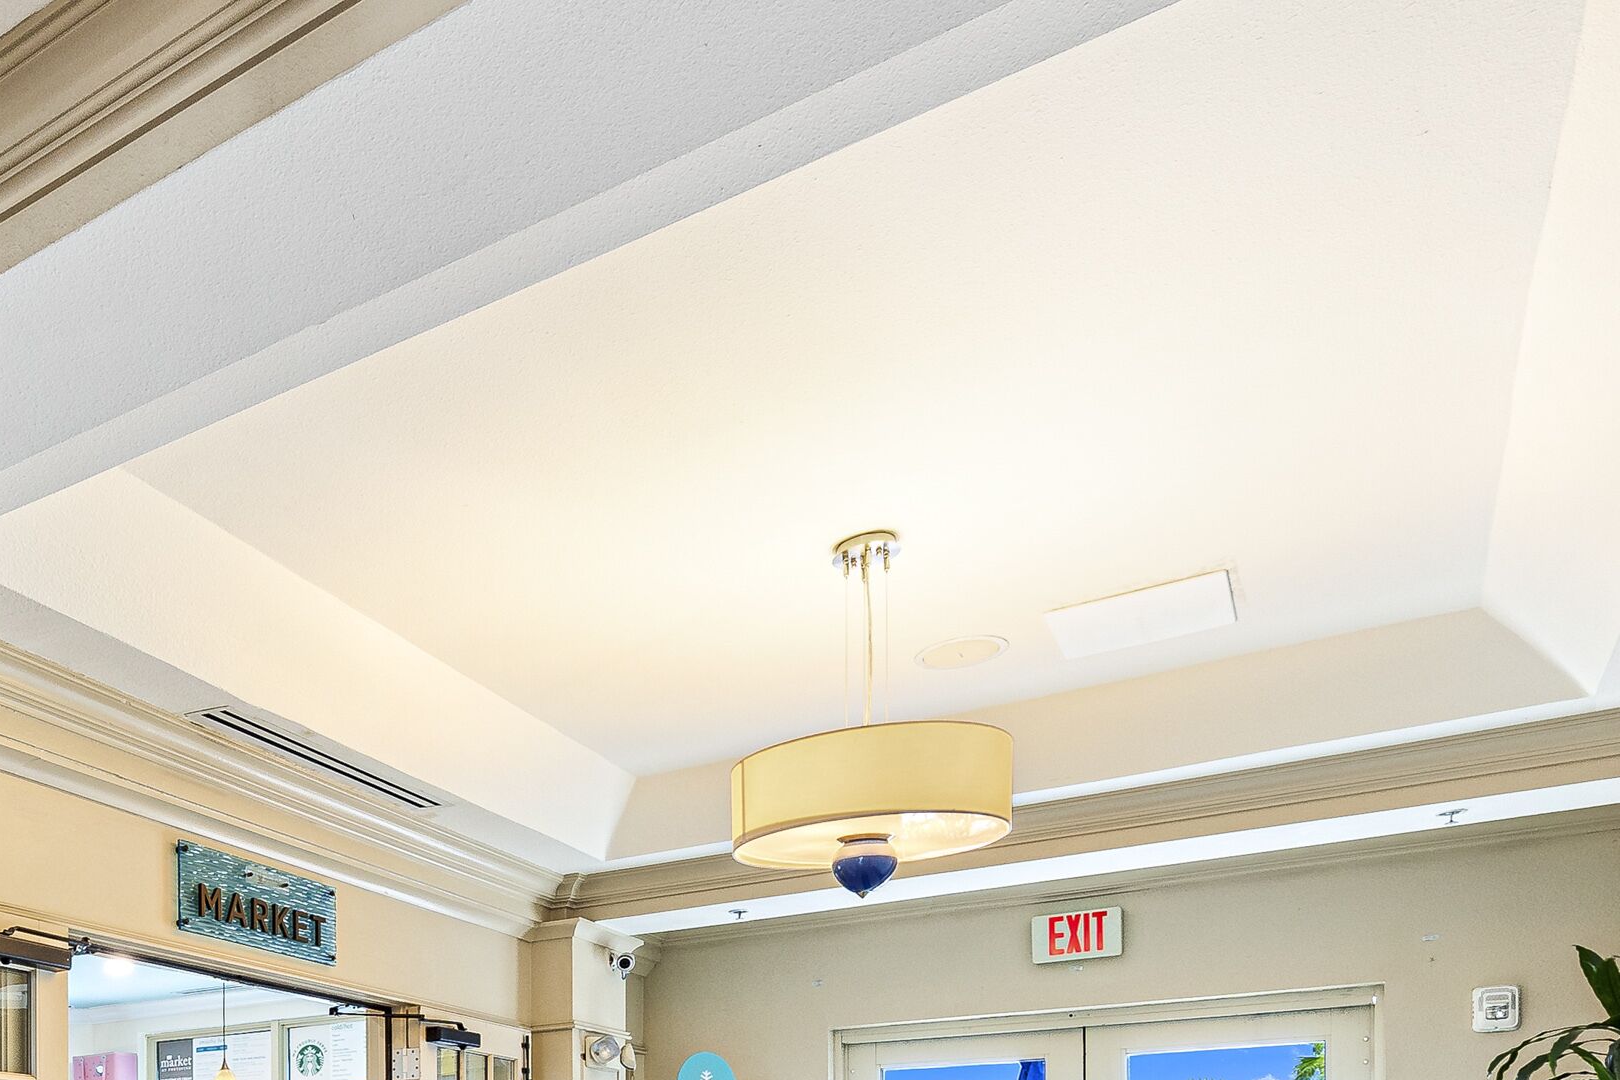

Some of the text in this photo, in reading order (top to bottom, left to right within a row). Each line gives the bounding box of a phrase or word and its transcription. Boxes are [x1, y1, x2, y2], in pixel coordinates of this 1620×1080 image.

[197, 882, 327, 948] MARKET
[1048, 911, 1108, 956] EXIT
[160, 1055, 192, 1068] market
